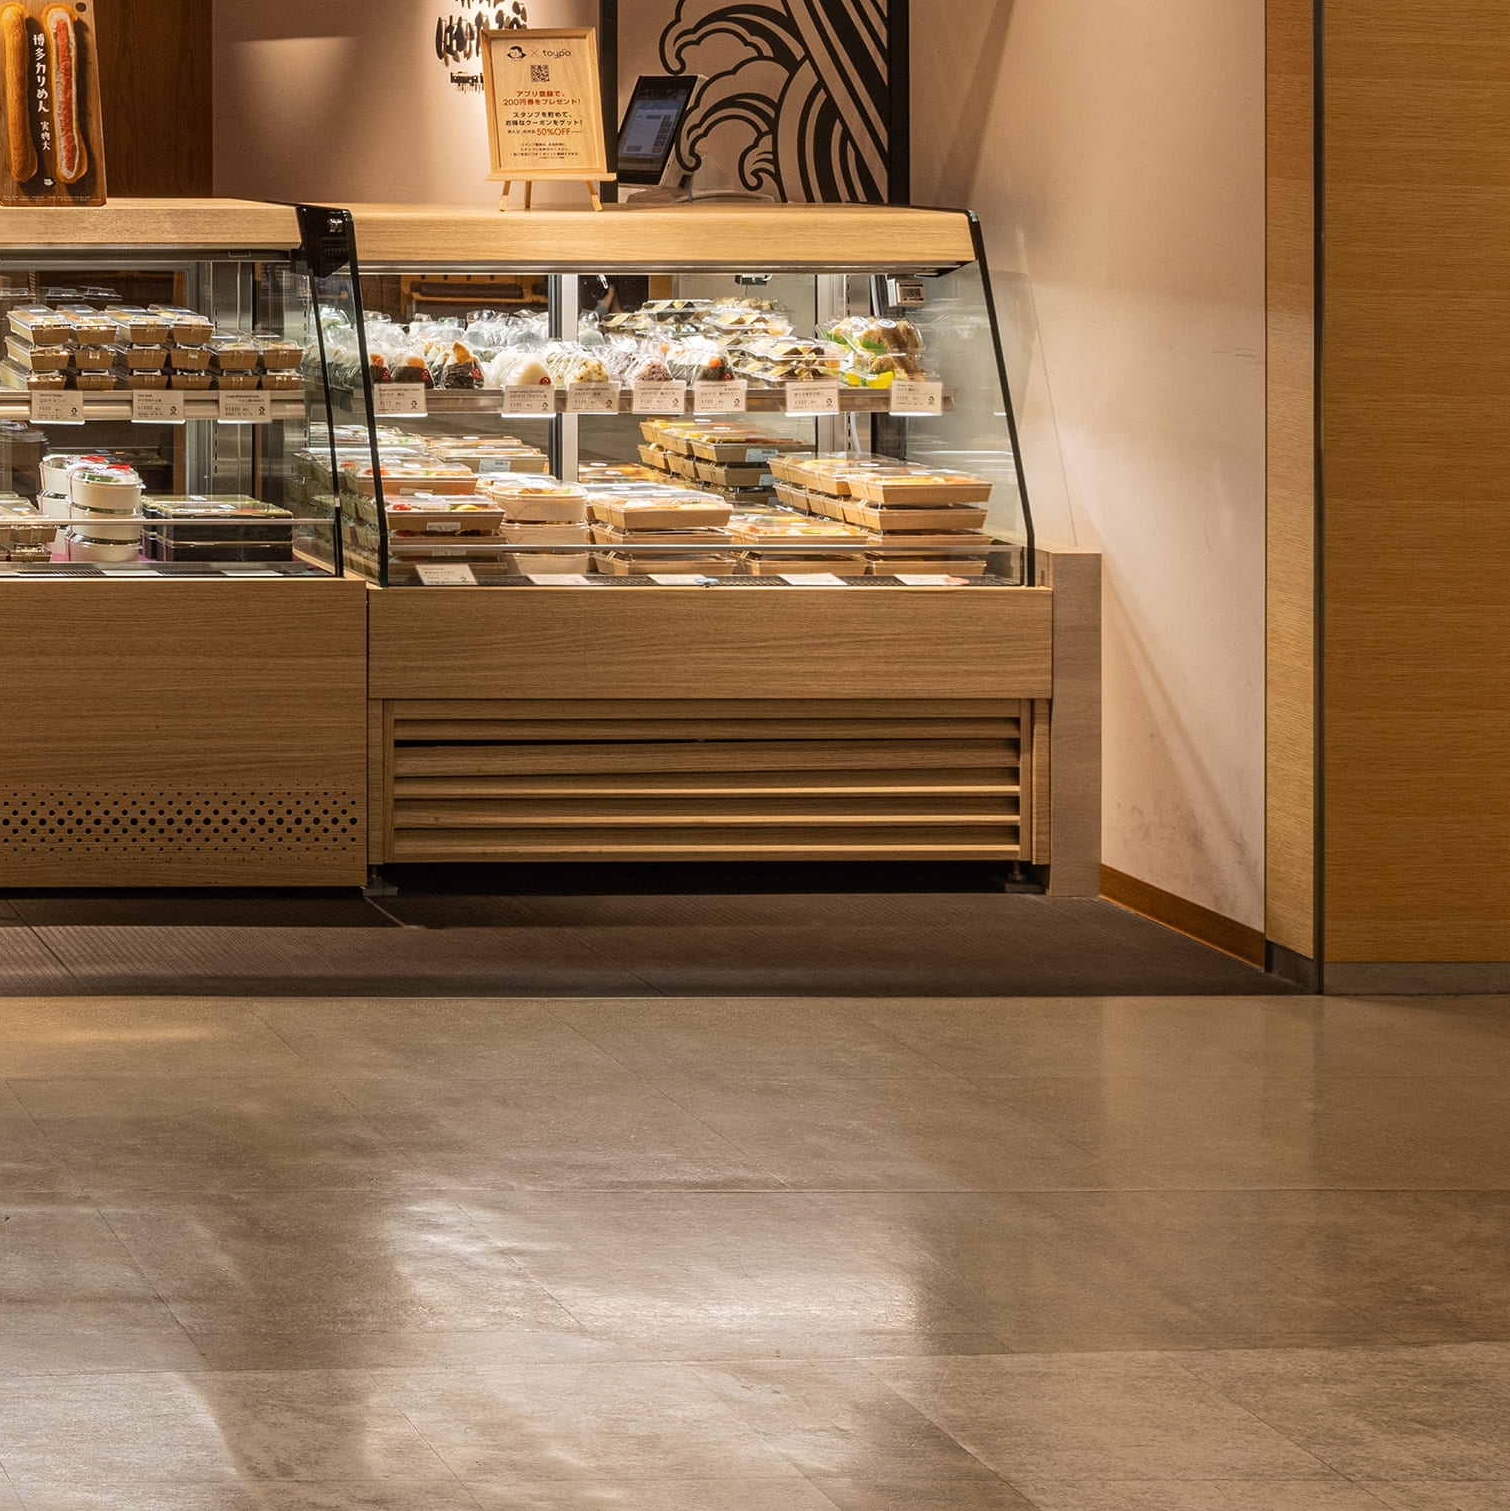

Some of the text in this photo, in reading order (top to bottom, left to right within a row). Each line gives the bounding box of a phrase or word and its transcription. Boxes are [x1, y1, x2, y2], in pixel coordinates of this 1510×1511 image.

[32, 33, 50, 113] 博多カリめん
